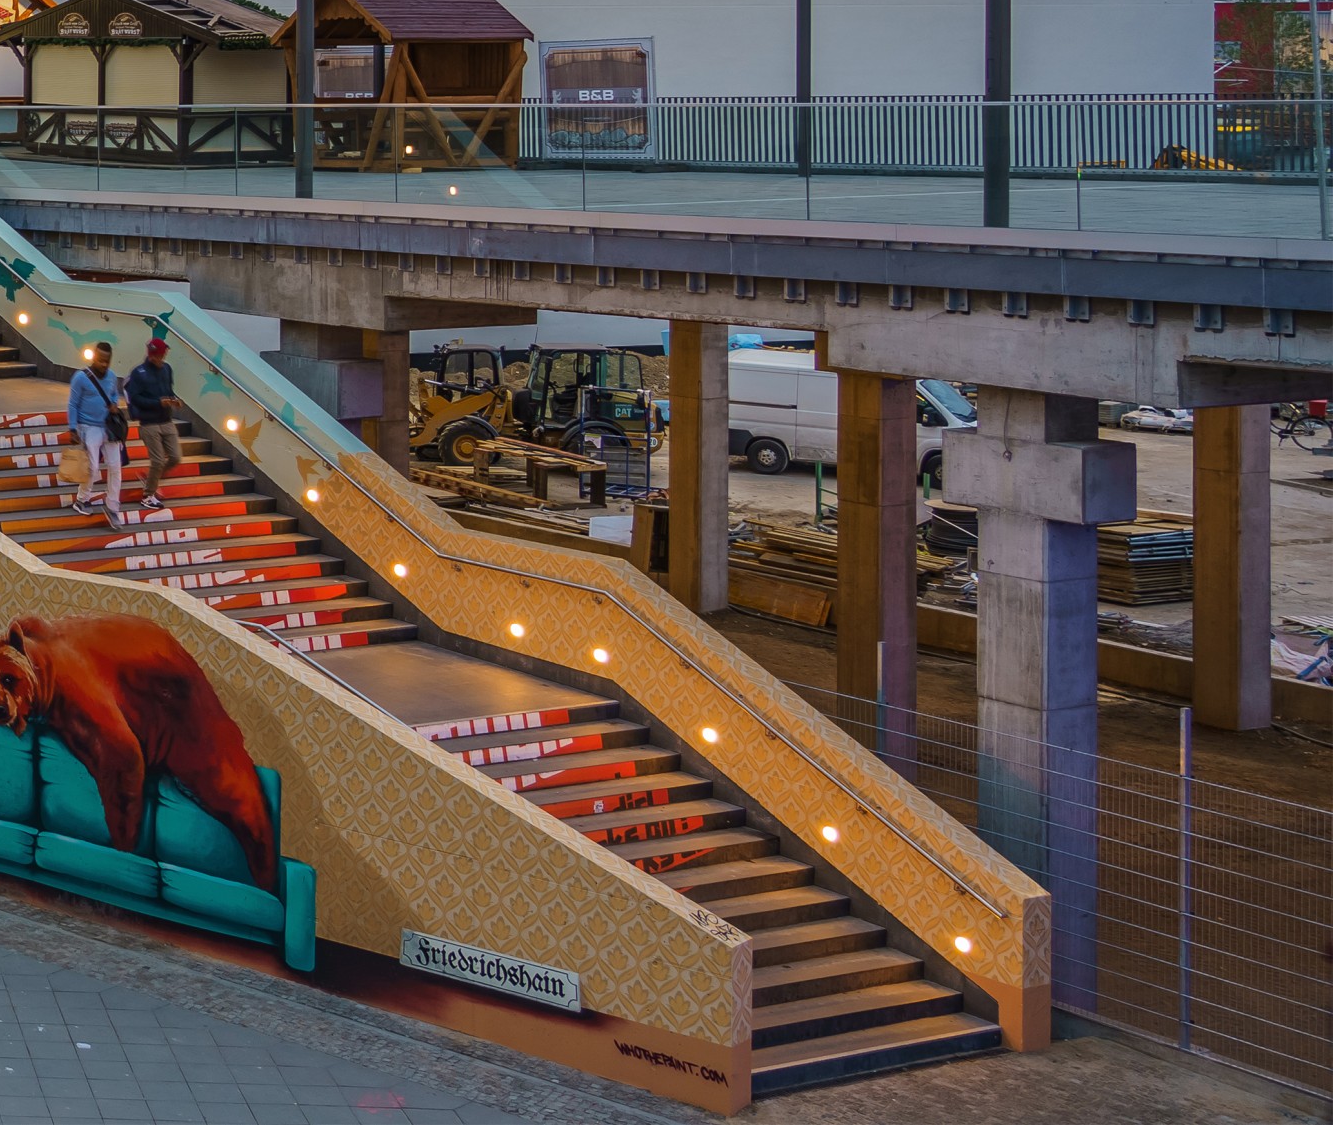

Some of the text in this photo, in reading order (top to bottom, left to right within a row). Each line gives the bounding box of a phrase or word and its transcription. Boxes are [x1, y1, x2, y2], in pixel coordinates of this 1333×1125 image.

[578, 89, 615, 101] B&B
[614, 407, 632, 418] CAT
[415, 937, 566, 998] Friedrichshain
